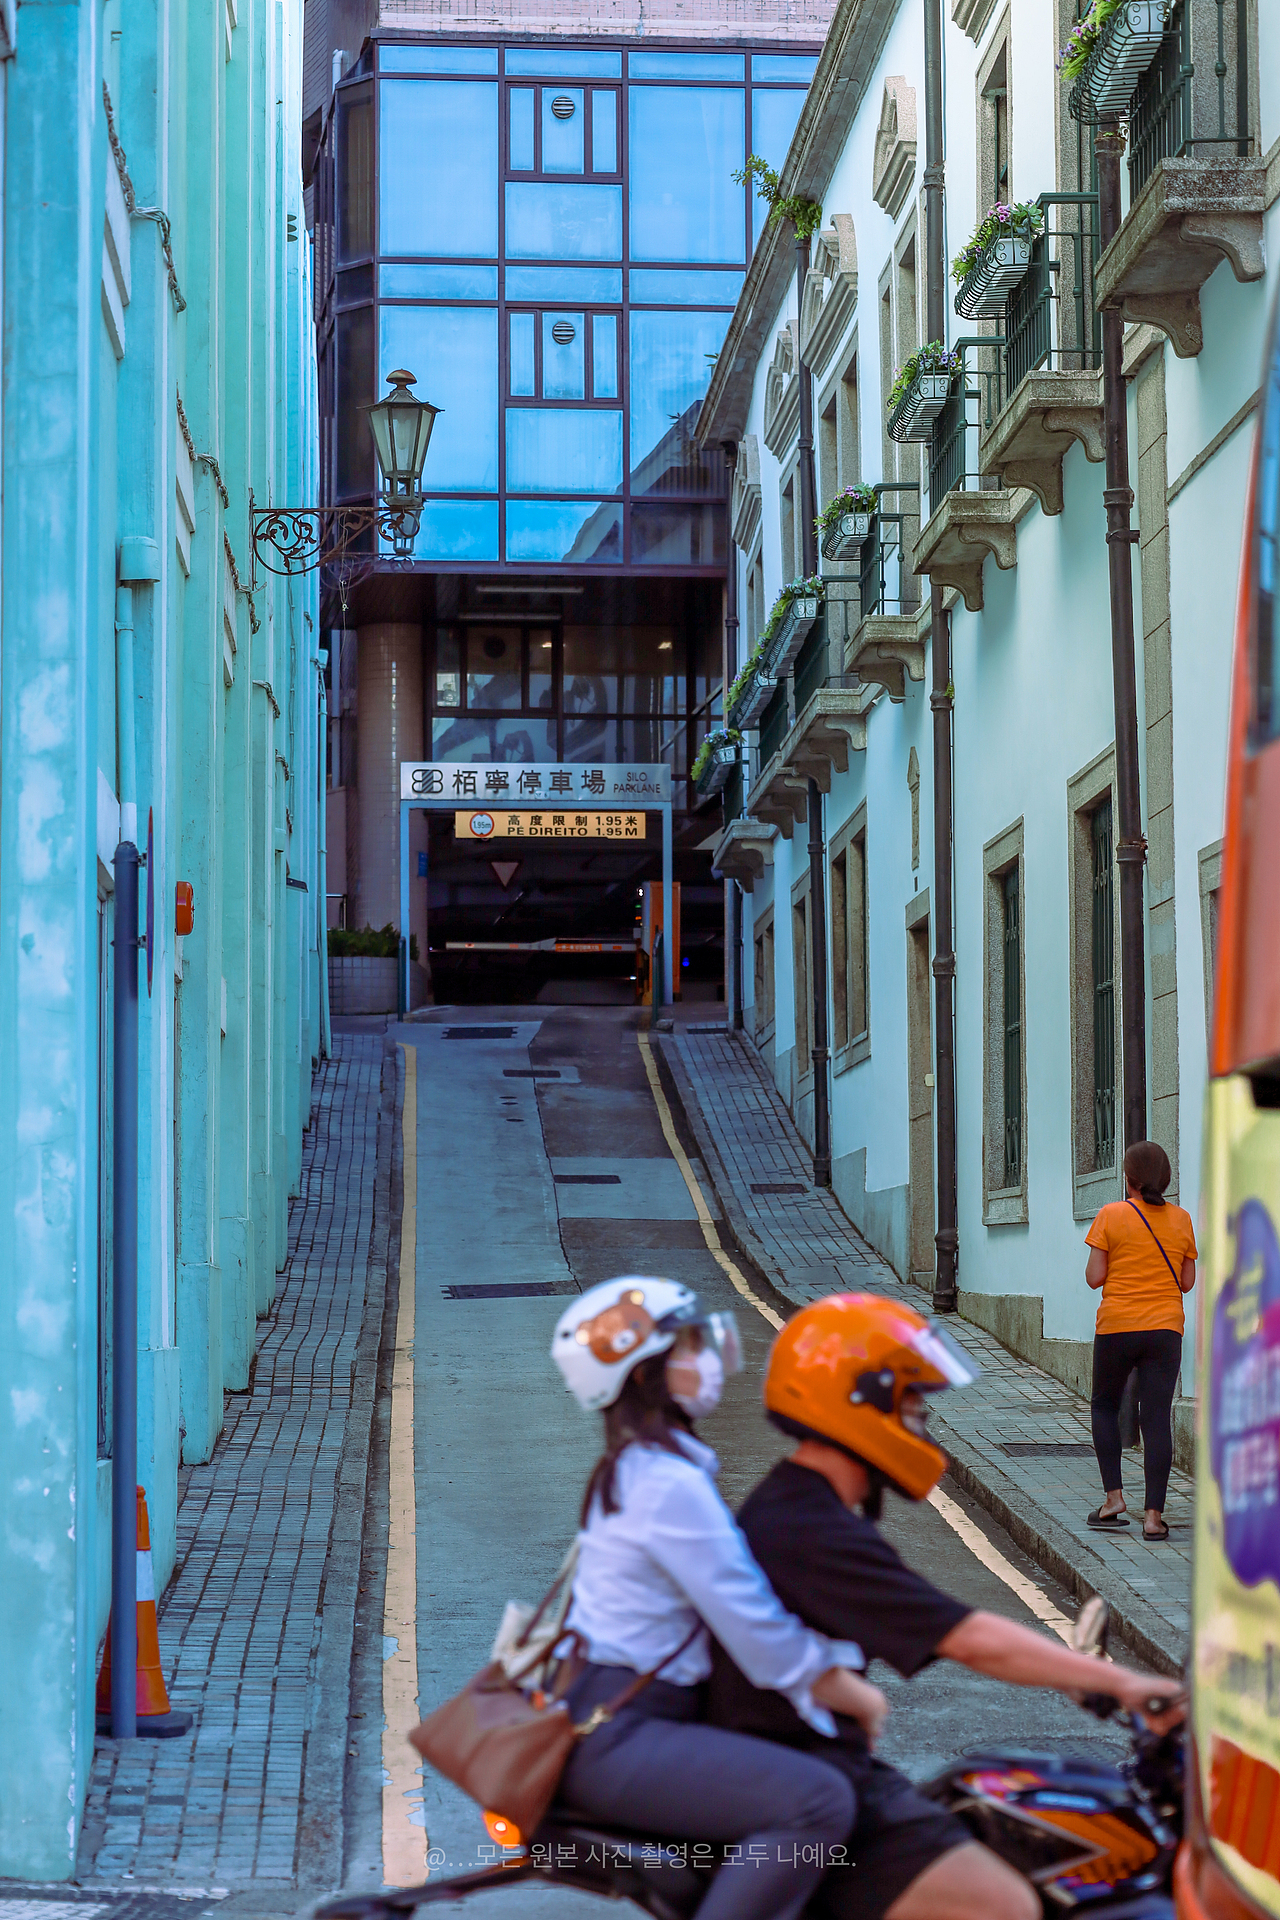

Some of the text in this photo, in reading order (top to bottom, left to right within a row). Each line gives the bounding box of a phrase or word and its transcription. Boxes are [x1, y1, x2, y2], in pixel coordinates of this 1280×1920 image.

[452, 769, 606, 795] 栢寧停車場
[626, 771, 648, 782] SILO
[613, 783, 661, 794] PARKLANE
[507, 814, 588, 827] 高度限制
[528, 827, 588, 836] DIREITO
